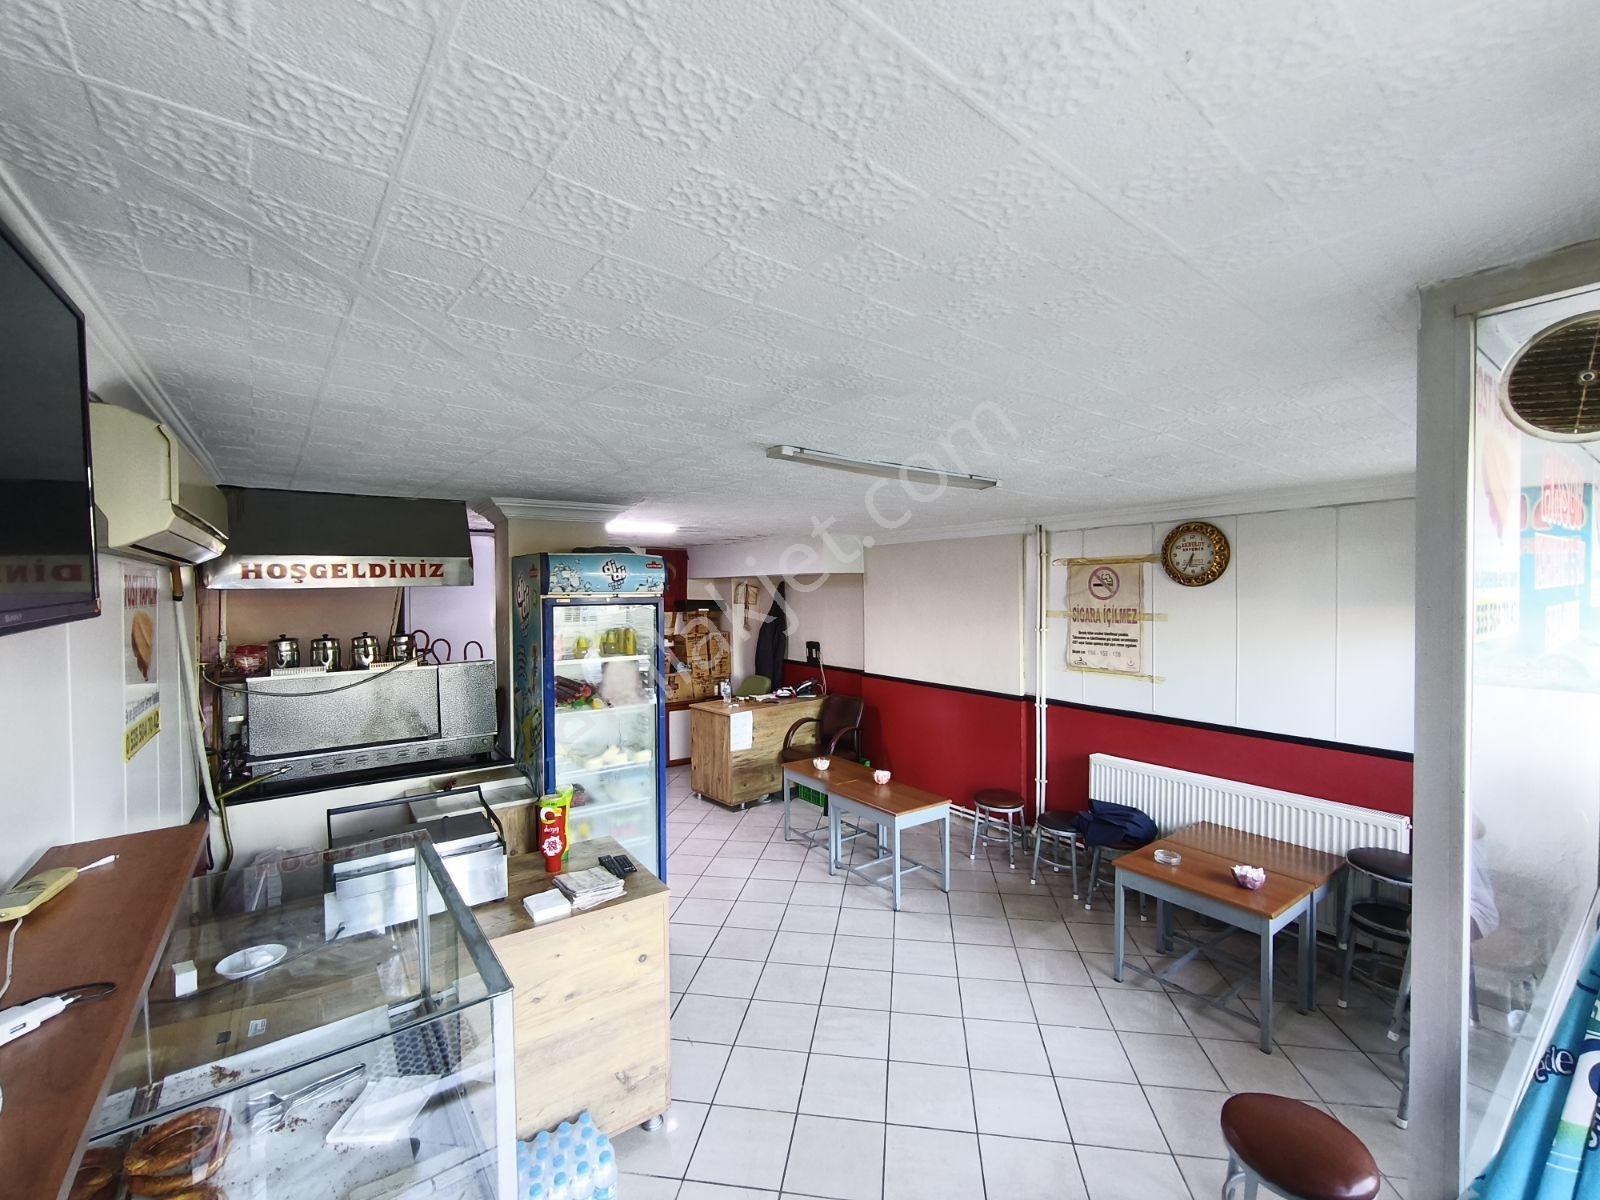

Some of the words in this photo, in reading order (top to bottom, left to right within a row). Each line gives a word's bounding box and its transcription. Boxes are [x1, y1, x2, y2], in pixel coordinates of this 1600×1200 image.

[239, 559, 445, 583] HOŞGELDİNİZ
[1072, 604, 1101, 623] SİGARA
[1103, 604, 1138, 628] İÇİLMEZ
